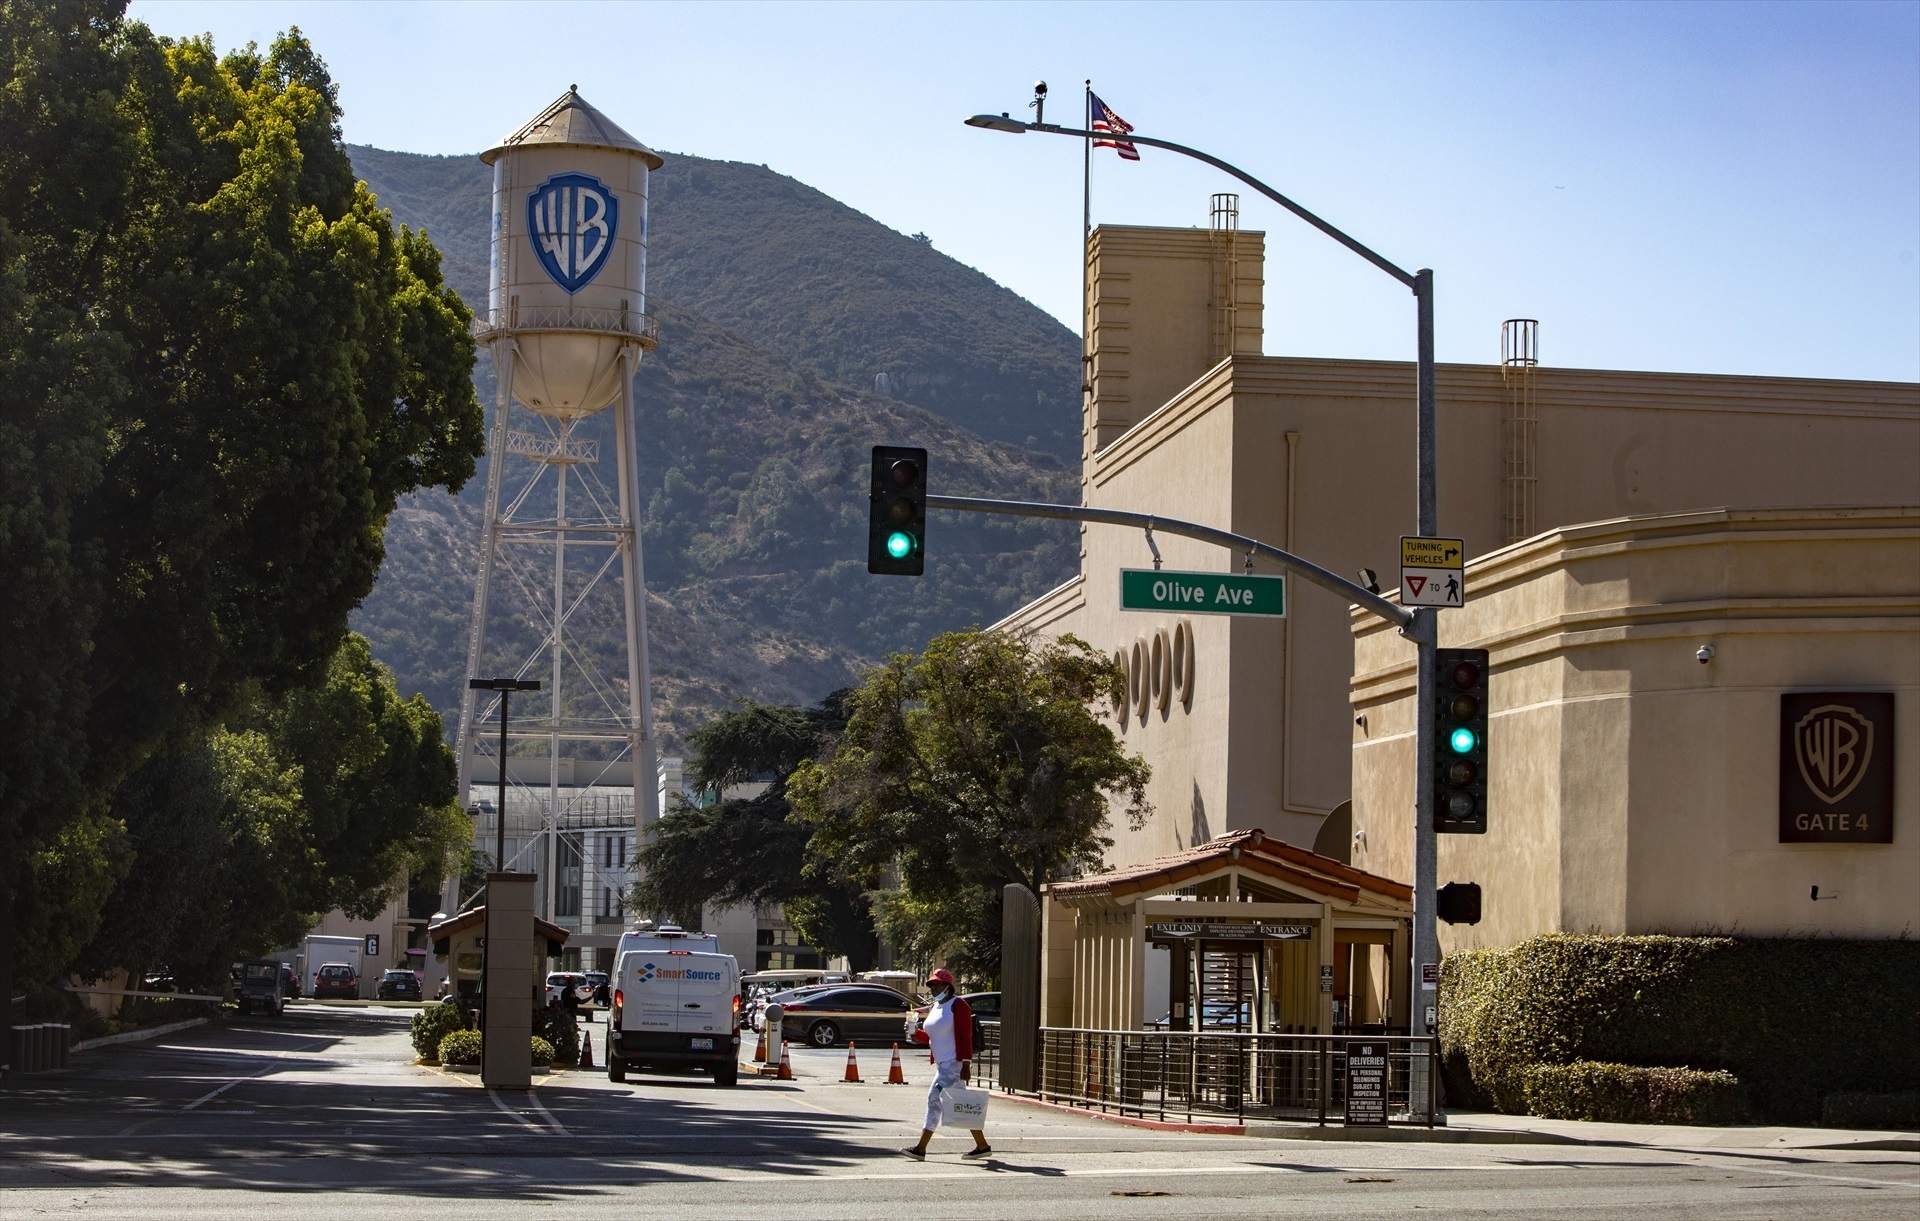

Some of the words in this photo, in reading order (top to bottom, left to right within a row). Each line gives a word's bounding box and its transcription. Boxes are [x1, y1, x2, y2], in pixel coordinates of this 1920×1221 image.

[535, 186, 609, 280] WB
[1406, 542, 1443, 551] TURNING
[1405, 554, 1443, 564] VEHICLES
[1430, 583, 1441, 592] TO
[1152, 580, 1205, 603] Olive
[1214, 583, 1254, 606] Ave
[1805, 717, 1859, 788] WB
[1795, 813, 1850, 831] GATE
[1855, 813, 1869, 831] 4
[1157, 923, 1177, 931] EXIT
[1180, 923, 1202, 932] ONLY
[1260, 925, 1309, 934] ENTRANCE
[368, 939, 377, 954] G
[656, 968, 721, 981] SmartSource
[1362, 1046, 1373, 1055] NO
[1349, 1056, 1385, 1065] DELIVERIES
